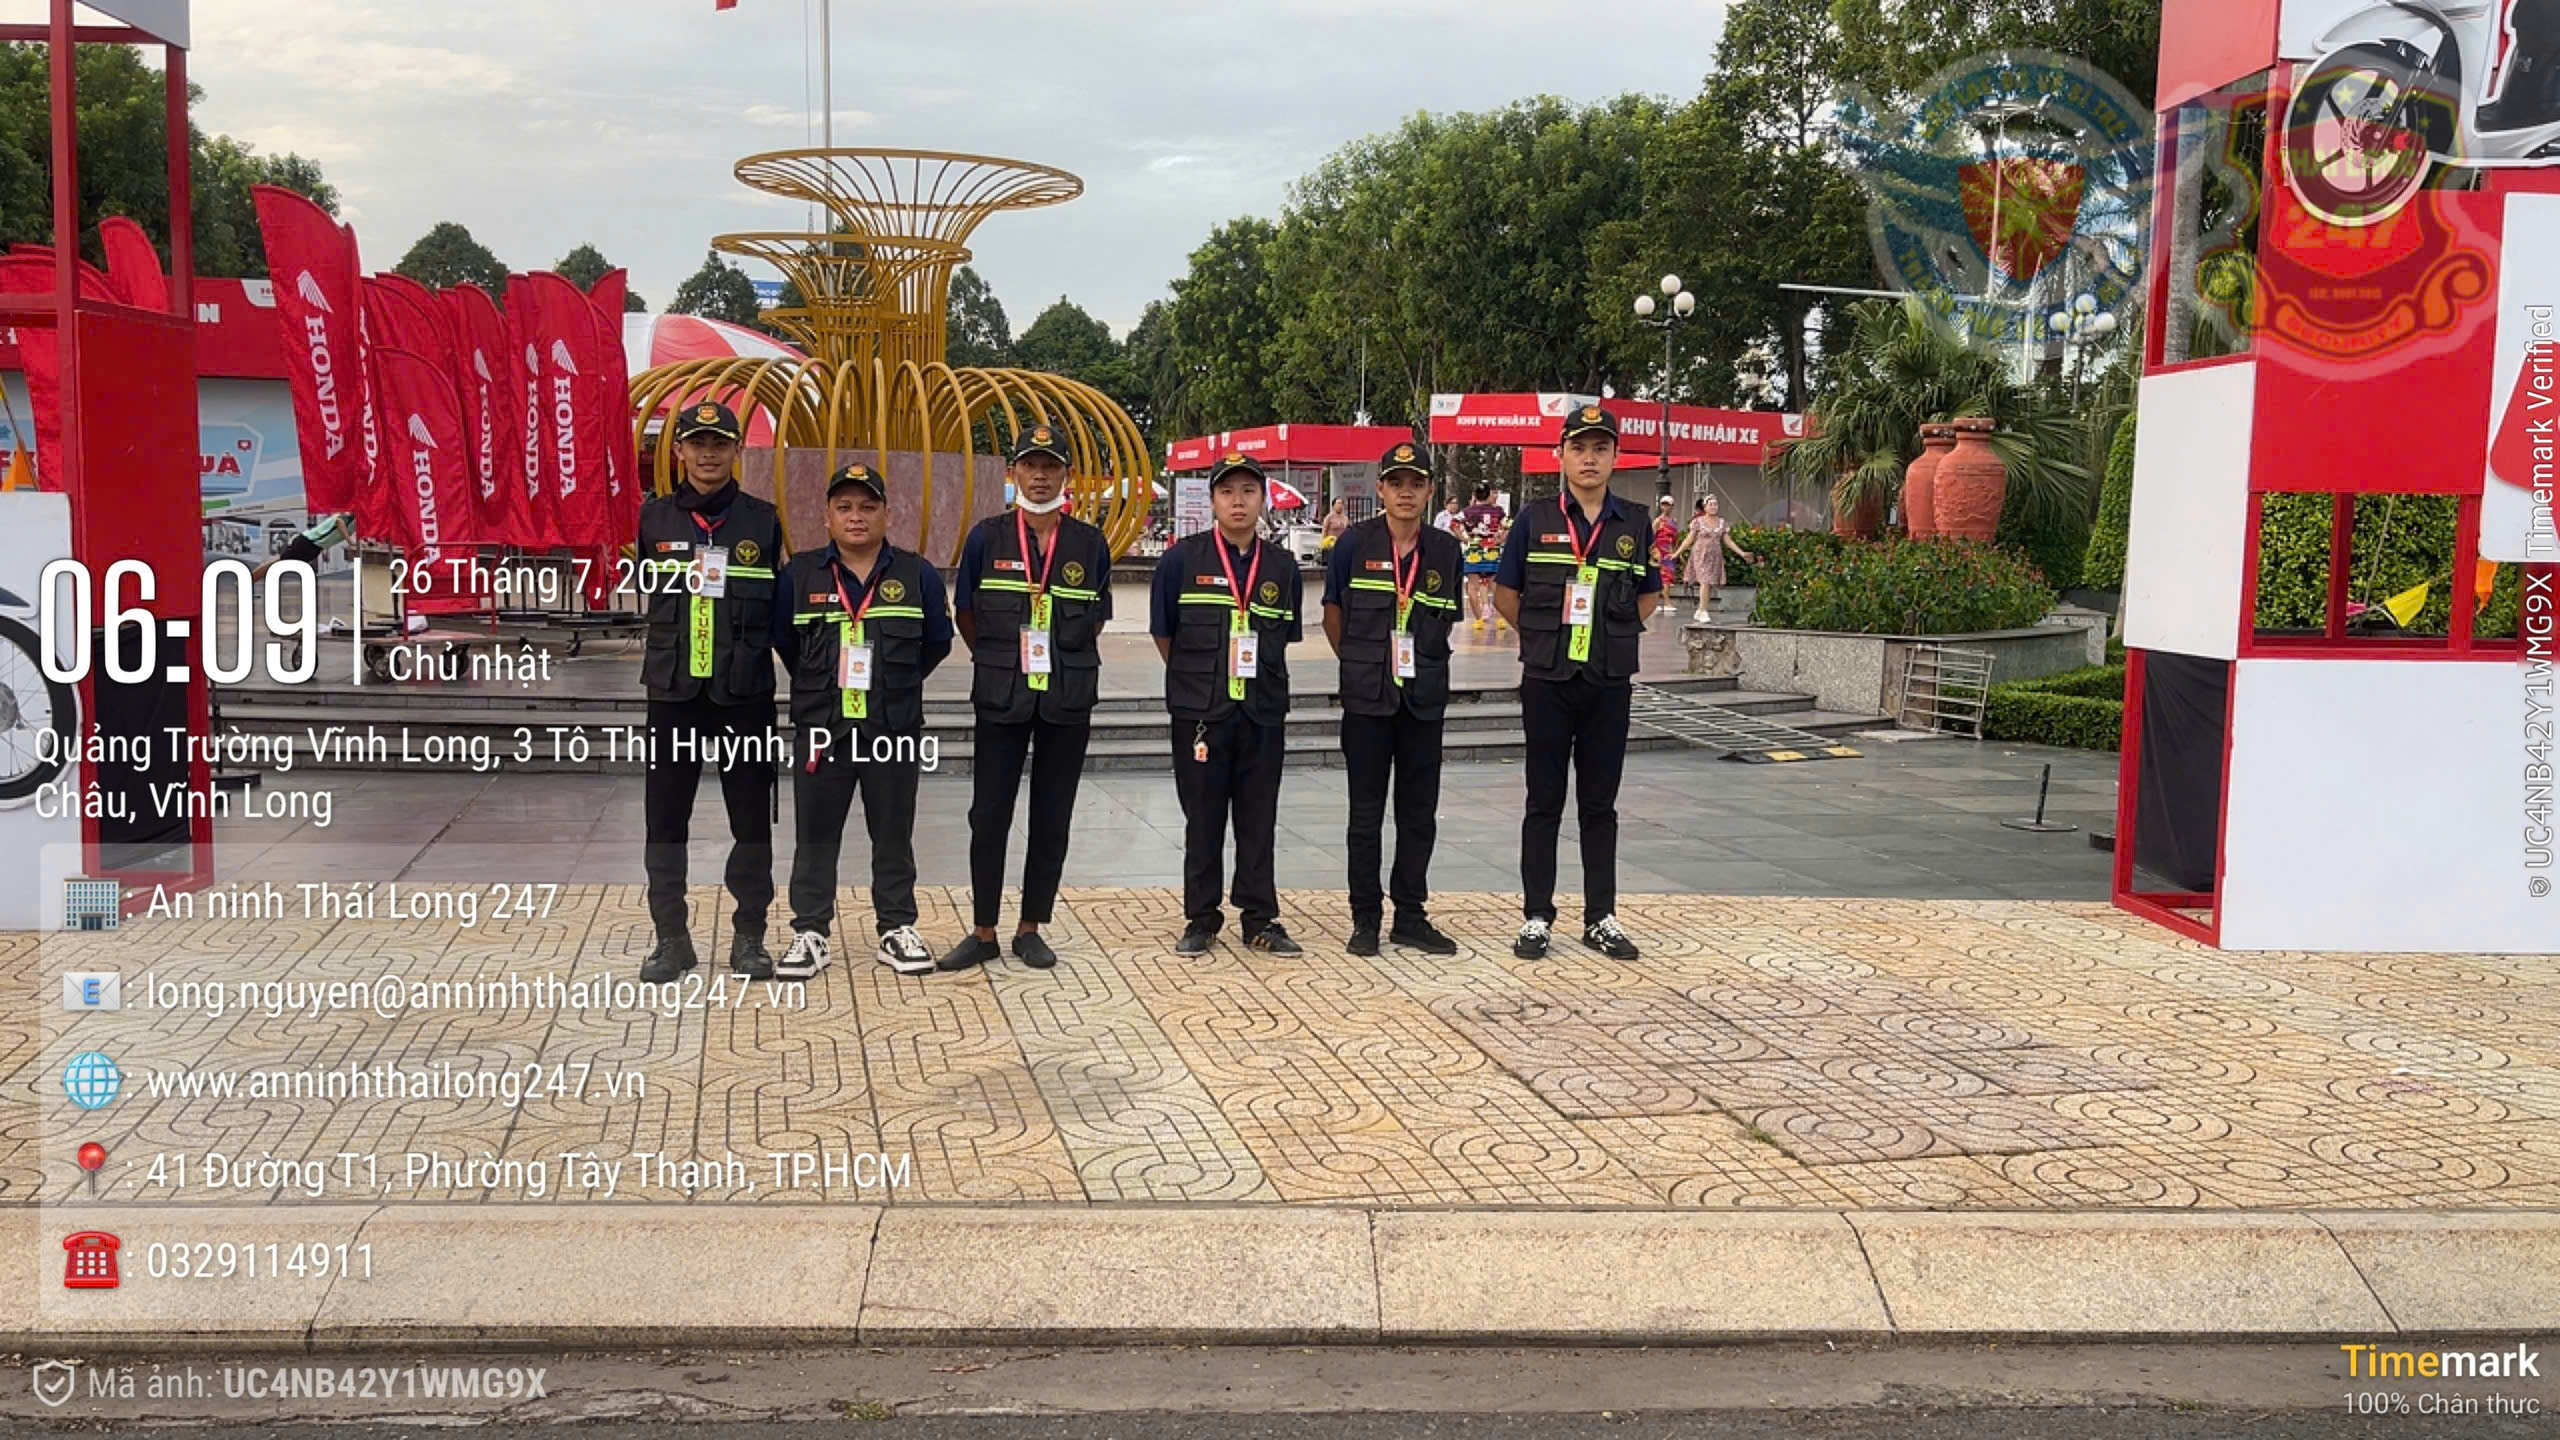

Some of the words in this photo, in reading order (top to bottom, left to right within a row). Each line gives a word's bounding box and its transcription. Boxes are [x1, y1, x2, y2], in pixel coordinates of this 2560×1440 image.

[305, 315, 345, 461] HONDA
[525, 379, 539, 502] HONDA
[553, 375, 577, 500] HONDA
[1620, 416, 1657, 438] KHU
[1692, 423, 1736, 445] NHẬN
[1738, 427, 1759, 445] XE
[413, 449, 441, 568] HONDA
[696, 597, 710, 673] ECURITY
